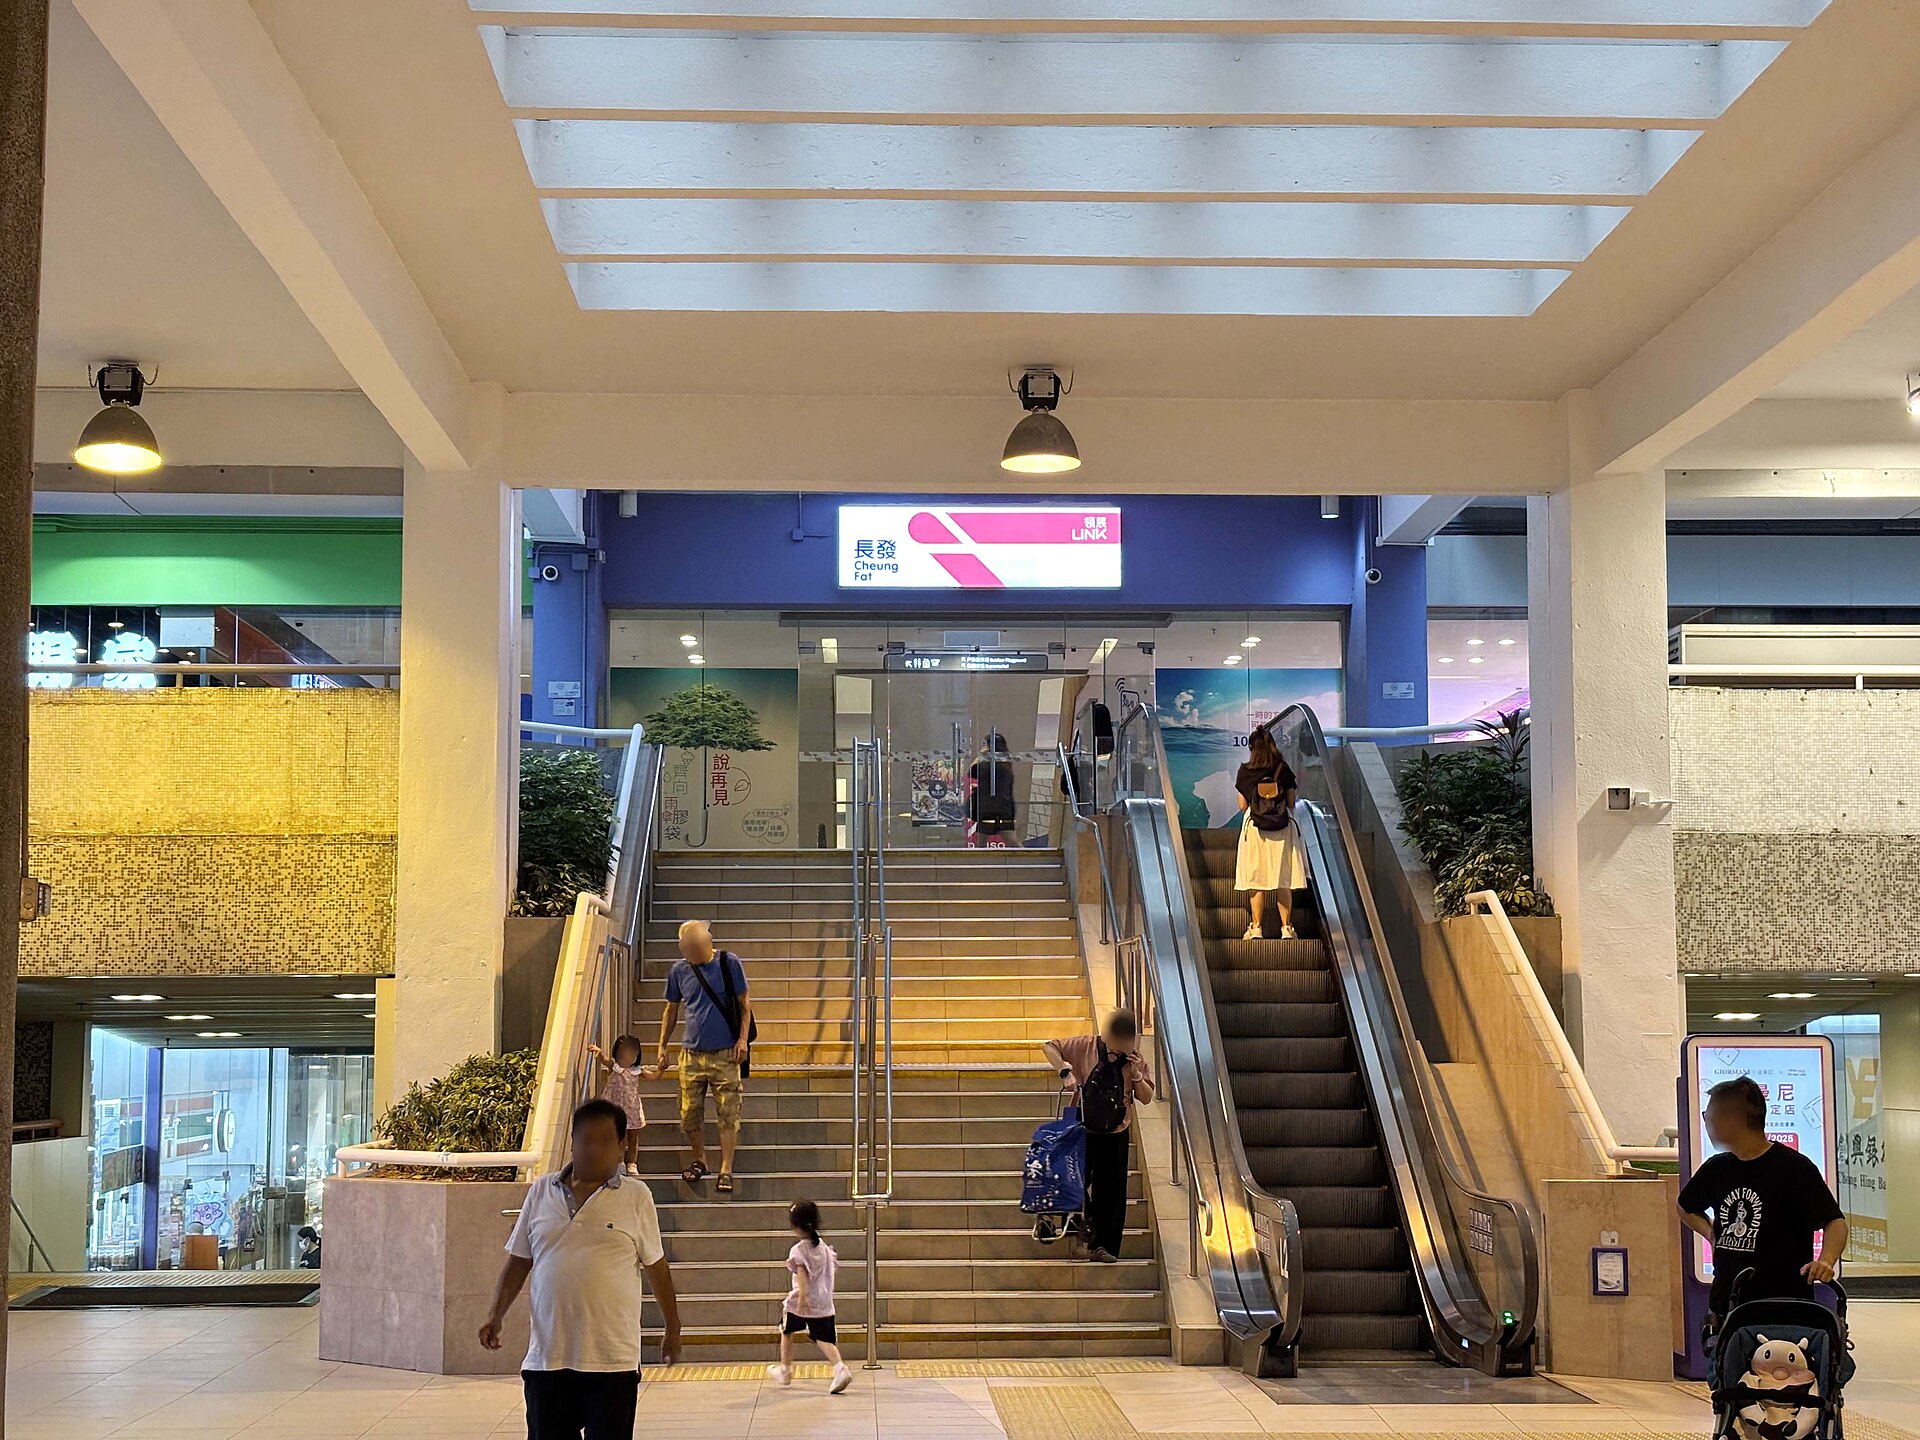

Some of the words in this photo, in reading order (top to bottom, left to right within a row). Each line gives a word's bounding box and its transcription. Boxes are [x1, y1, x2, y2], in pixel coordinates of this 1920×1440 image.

[1083, 516, 1107, 528] 領展
[1071, 528, 1108, 541] LINK
[854, 539, 896, 559] 長發
[854, 560, 899, 573] Cheung
[854, 571, 873, 581] Fat
[710, 753, 730, 806] 說再見
[1860, 1174, 1875, 1192] Hing
[1724, 1188, 1740, 1207] WAY
[1719, 1205, 1730, 1227] THE
[1741, 1187, 1763, 1228] FORWARD
